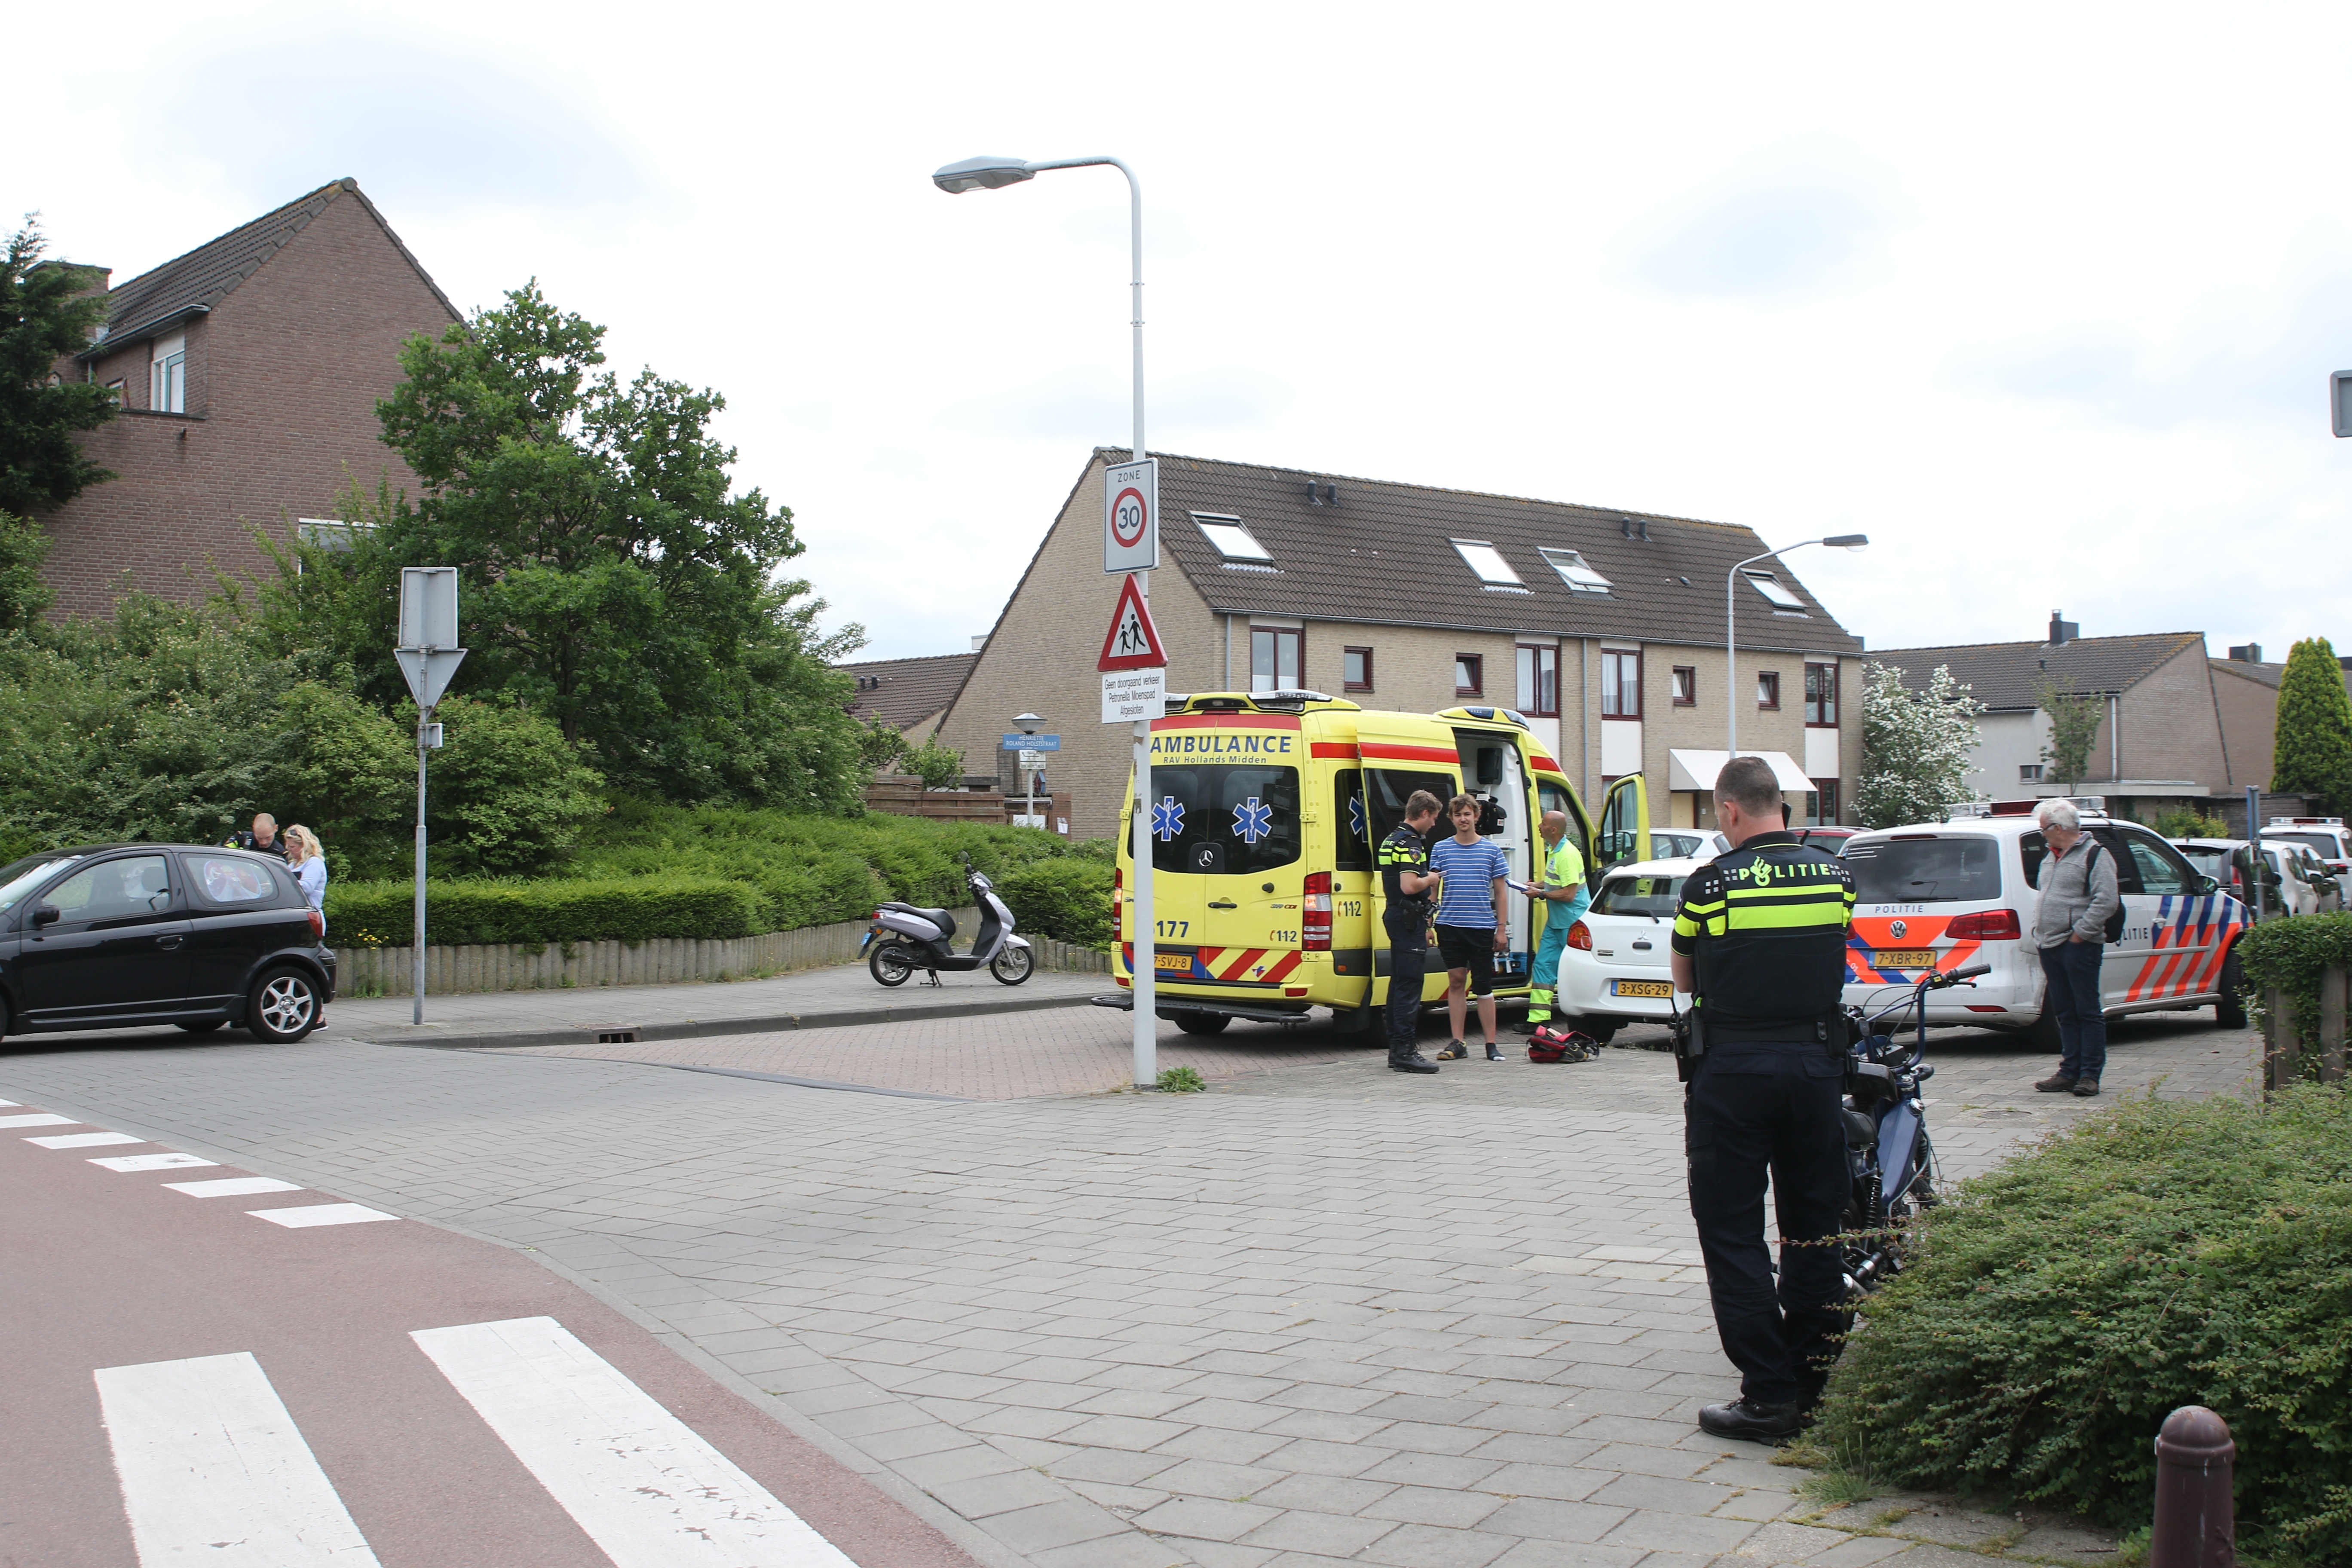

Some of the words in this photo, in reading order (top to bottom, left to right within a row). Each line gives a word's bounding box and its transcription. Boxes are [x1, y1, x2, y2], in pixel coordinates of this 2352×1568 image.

[1118, 470, 1141, 483] ZONE
[1118, 505, 1140, 529] 30
[1105, 679, 1116, 690] Geen
[1117, 675, 1142, 690] doorgaand
[1143, 674, 1160, 685] verkeer
[1109, 691, 1130, 703] Petronella
[1132, 688, 1155, 702] Moenspad
[1120, 704, 1144, 718] Afgesloten
[1151, 736, 1292, 753] AMBULANCE
[1184, 756, 1225, 764] Hollands
[1229, 756, 1267, 764] Midden
[1738, 857, 1831, 886] POLITIE
[1875, 905, 1924, 914] POLITIE
[1153, 920, 1189, 938] 177
[2123, 927, 2148, 940] LITIE
[1878, 953, 1931, 965] 7-XBR-97
[1620, 983, 1669, 995] 3-XSG-29
